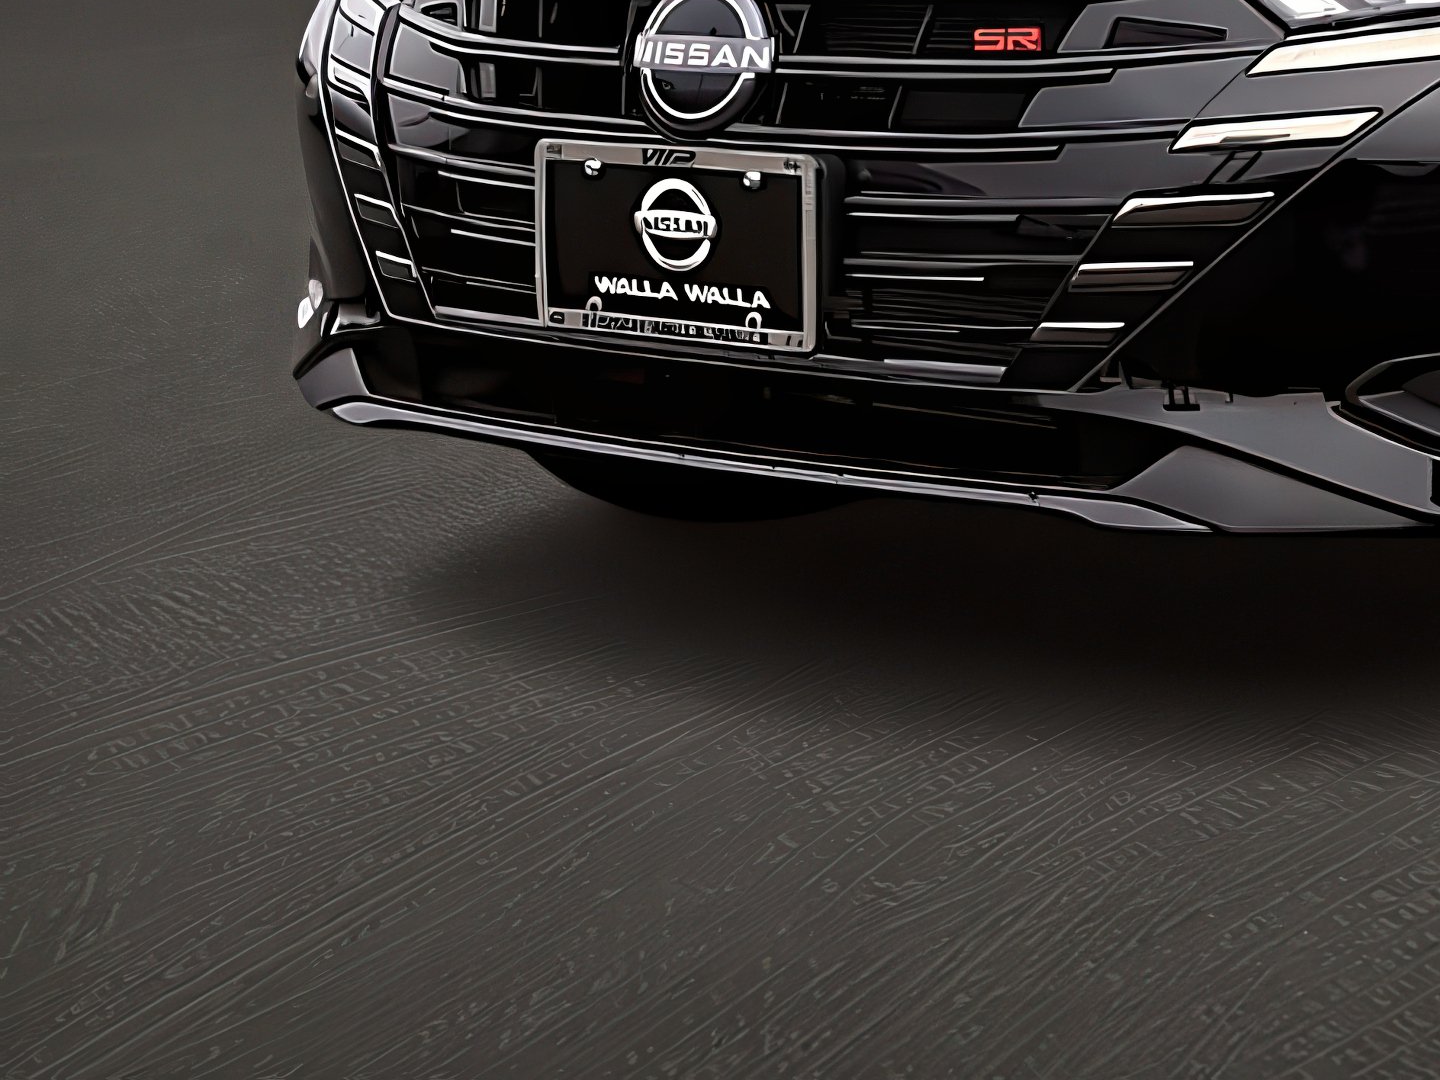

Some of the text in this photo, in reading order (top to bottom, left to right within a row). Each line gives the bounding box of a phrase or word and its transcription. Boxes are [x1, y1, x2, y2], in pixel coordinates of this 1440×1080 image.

[974, 27, 1041, 51] SR
[637, 40, 770, 69] NISSAN
[594, 275, 771, 309] WALLA WALLA
